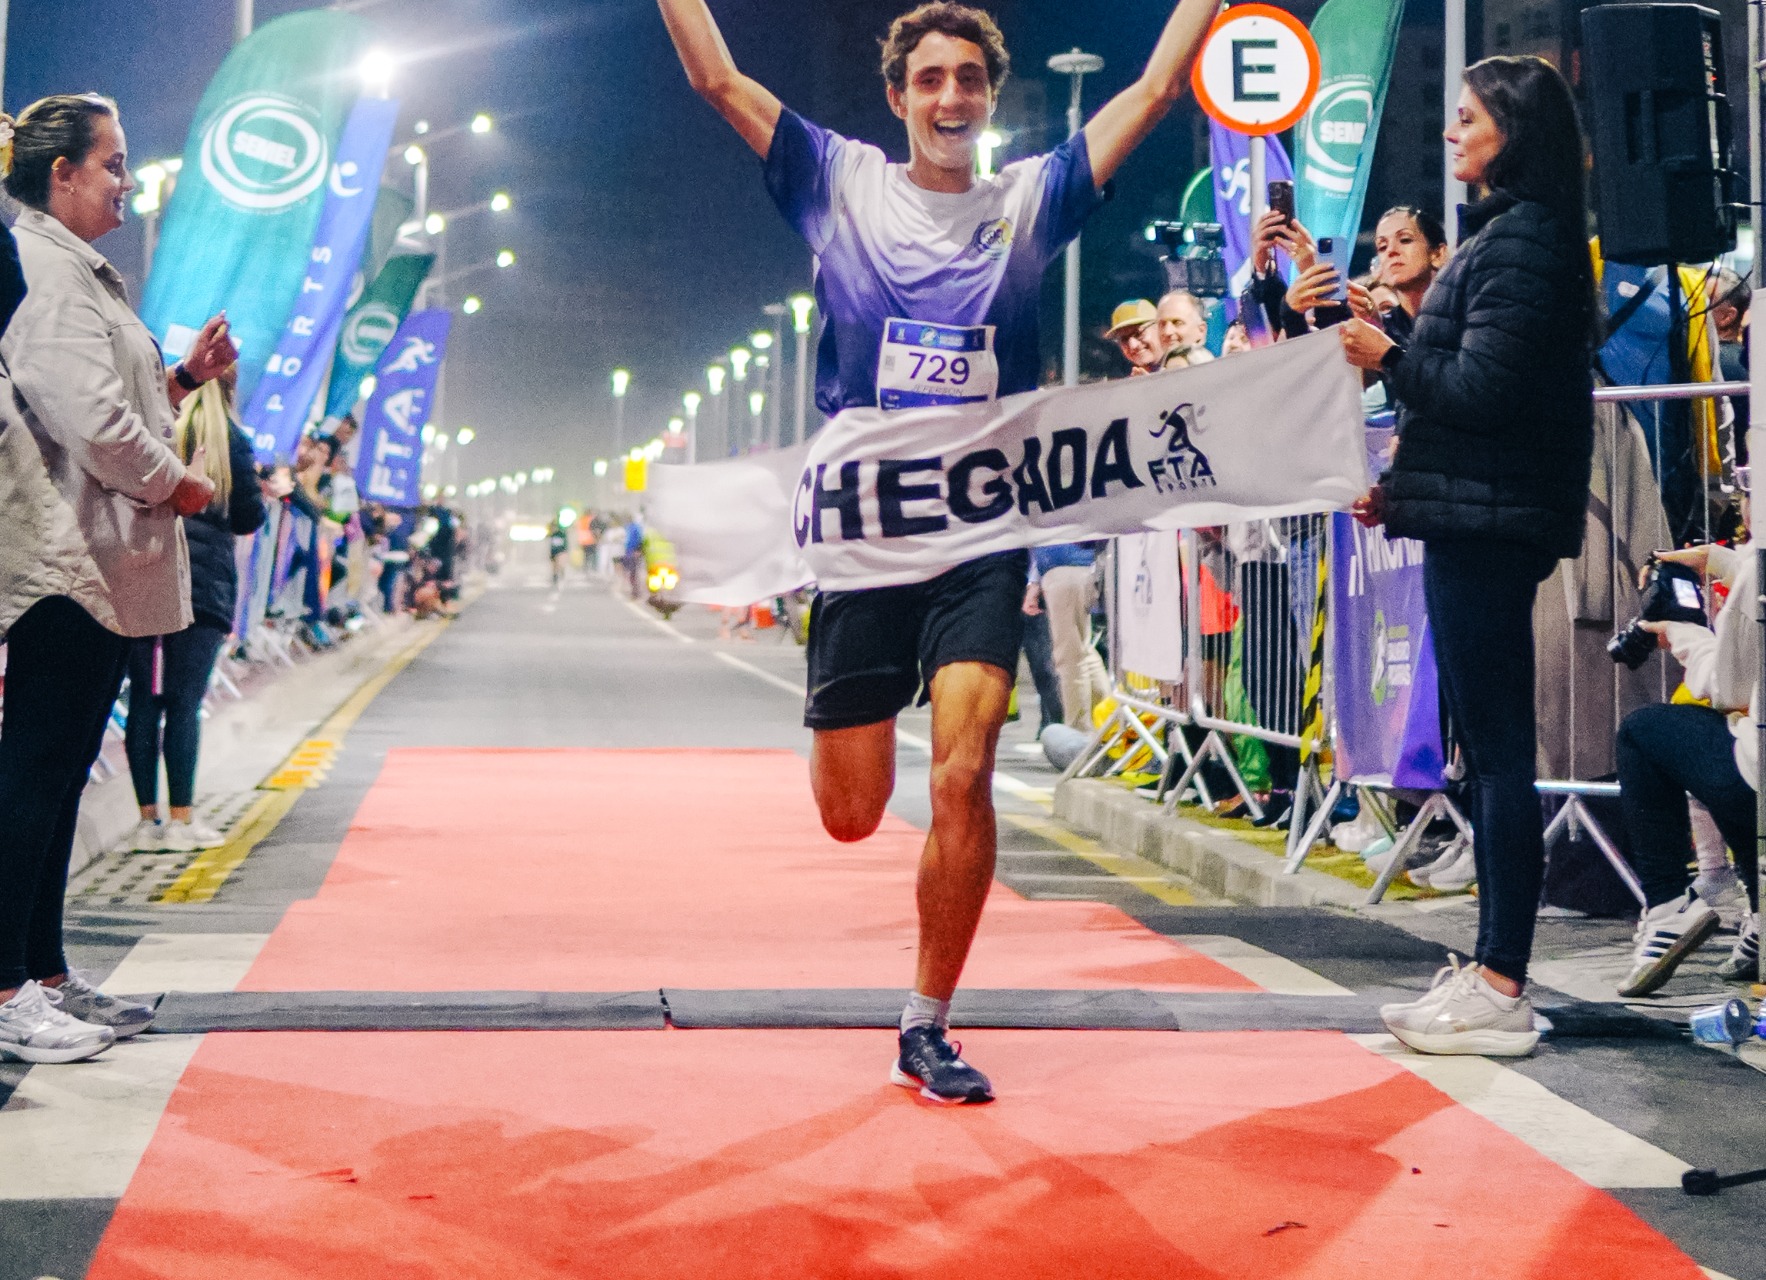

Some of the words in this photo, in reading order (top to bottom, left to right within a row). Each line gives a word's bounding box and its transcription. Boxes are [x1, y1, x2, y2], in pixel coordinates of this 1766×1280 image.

[1231, 38, 1281, 103] E
[255, 245, 333, 452] SPORTS
[908, 351, 971, 386] 729
[366, 387, 422, 503] FTA
[793, 417, 1146, 549] CHEGADA
[1147, 455, 1213, 484] FTA
